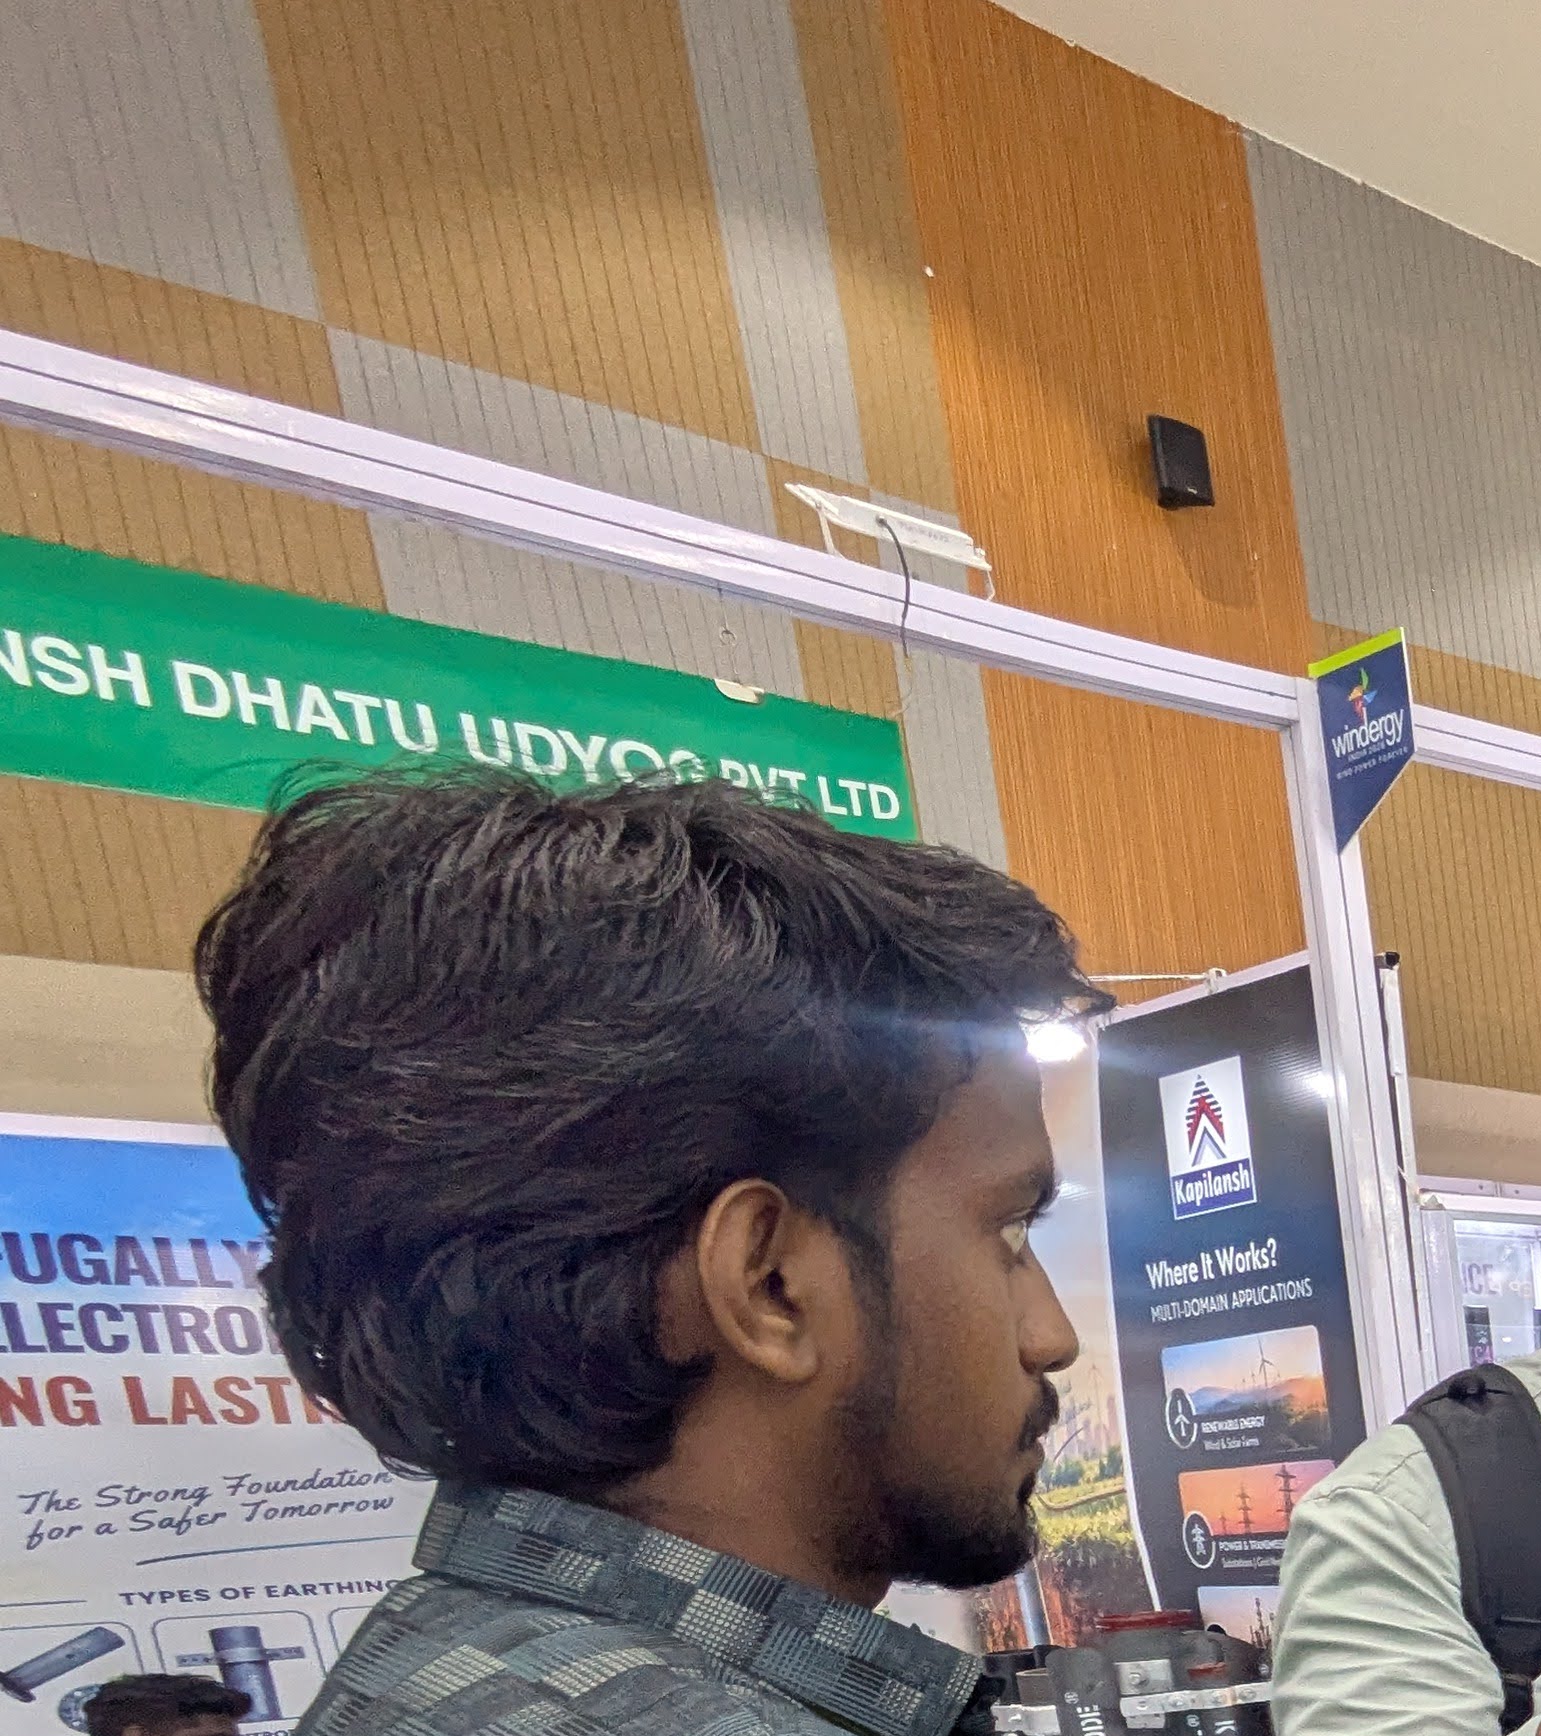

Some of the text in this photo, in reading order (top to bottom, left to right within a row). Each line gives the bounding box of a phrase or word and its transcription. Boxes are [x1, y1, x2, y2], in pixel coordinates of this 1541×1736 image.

[172, 657, 442, 757] DHATU
[817, 775, 900, 820] LTD
[1331, 706, 1404, 758] windergy
[1174, 1163, 1251, 1206] Kapilansh
[0, 1230, 268, 1290] UGALLY
[1146, 1237, 1278, 1290] Where It Works?
[1150, 1277, 1314, 1324] MULTI-DOMAIN APPLICATIONS
[0, 1302, 284, 1356] LECTRO
[18, 1468, 394, 1516] The Strong Foundation
[25, 1494, 395, 1550] for a Safer Tomorrow
[119, 1588, 212, 1607] TYPES
[219, 1585, 259, 1601] OF
